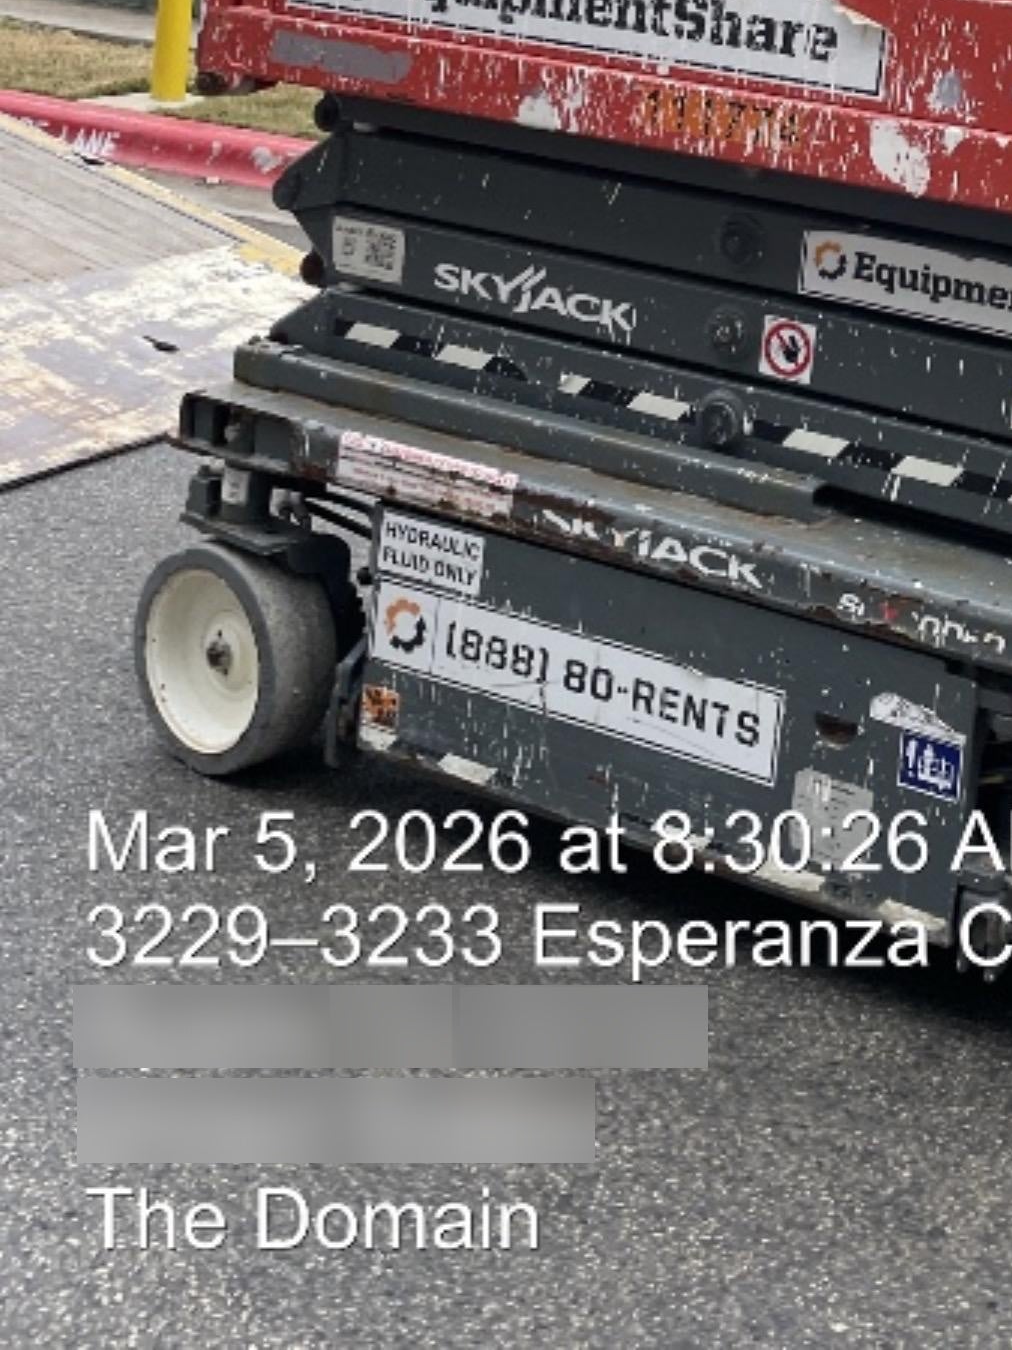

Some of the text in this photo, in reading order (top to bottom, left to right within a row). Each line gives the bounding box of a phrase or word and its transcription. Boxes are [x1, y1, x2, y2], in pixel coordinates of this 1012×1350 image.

[434, 263, 637, 333] SKYJACK
[382, 545, 477, 586] FLUID ONLY
[385, 521, 481, 562] HYDRAULIC
[562, 660, 761, 748] 80-RENTS
